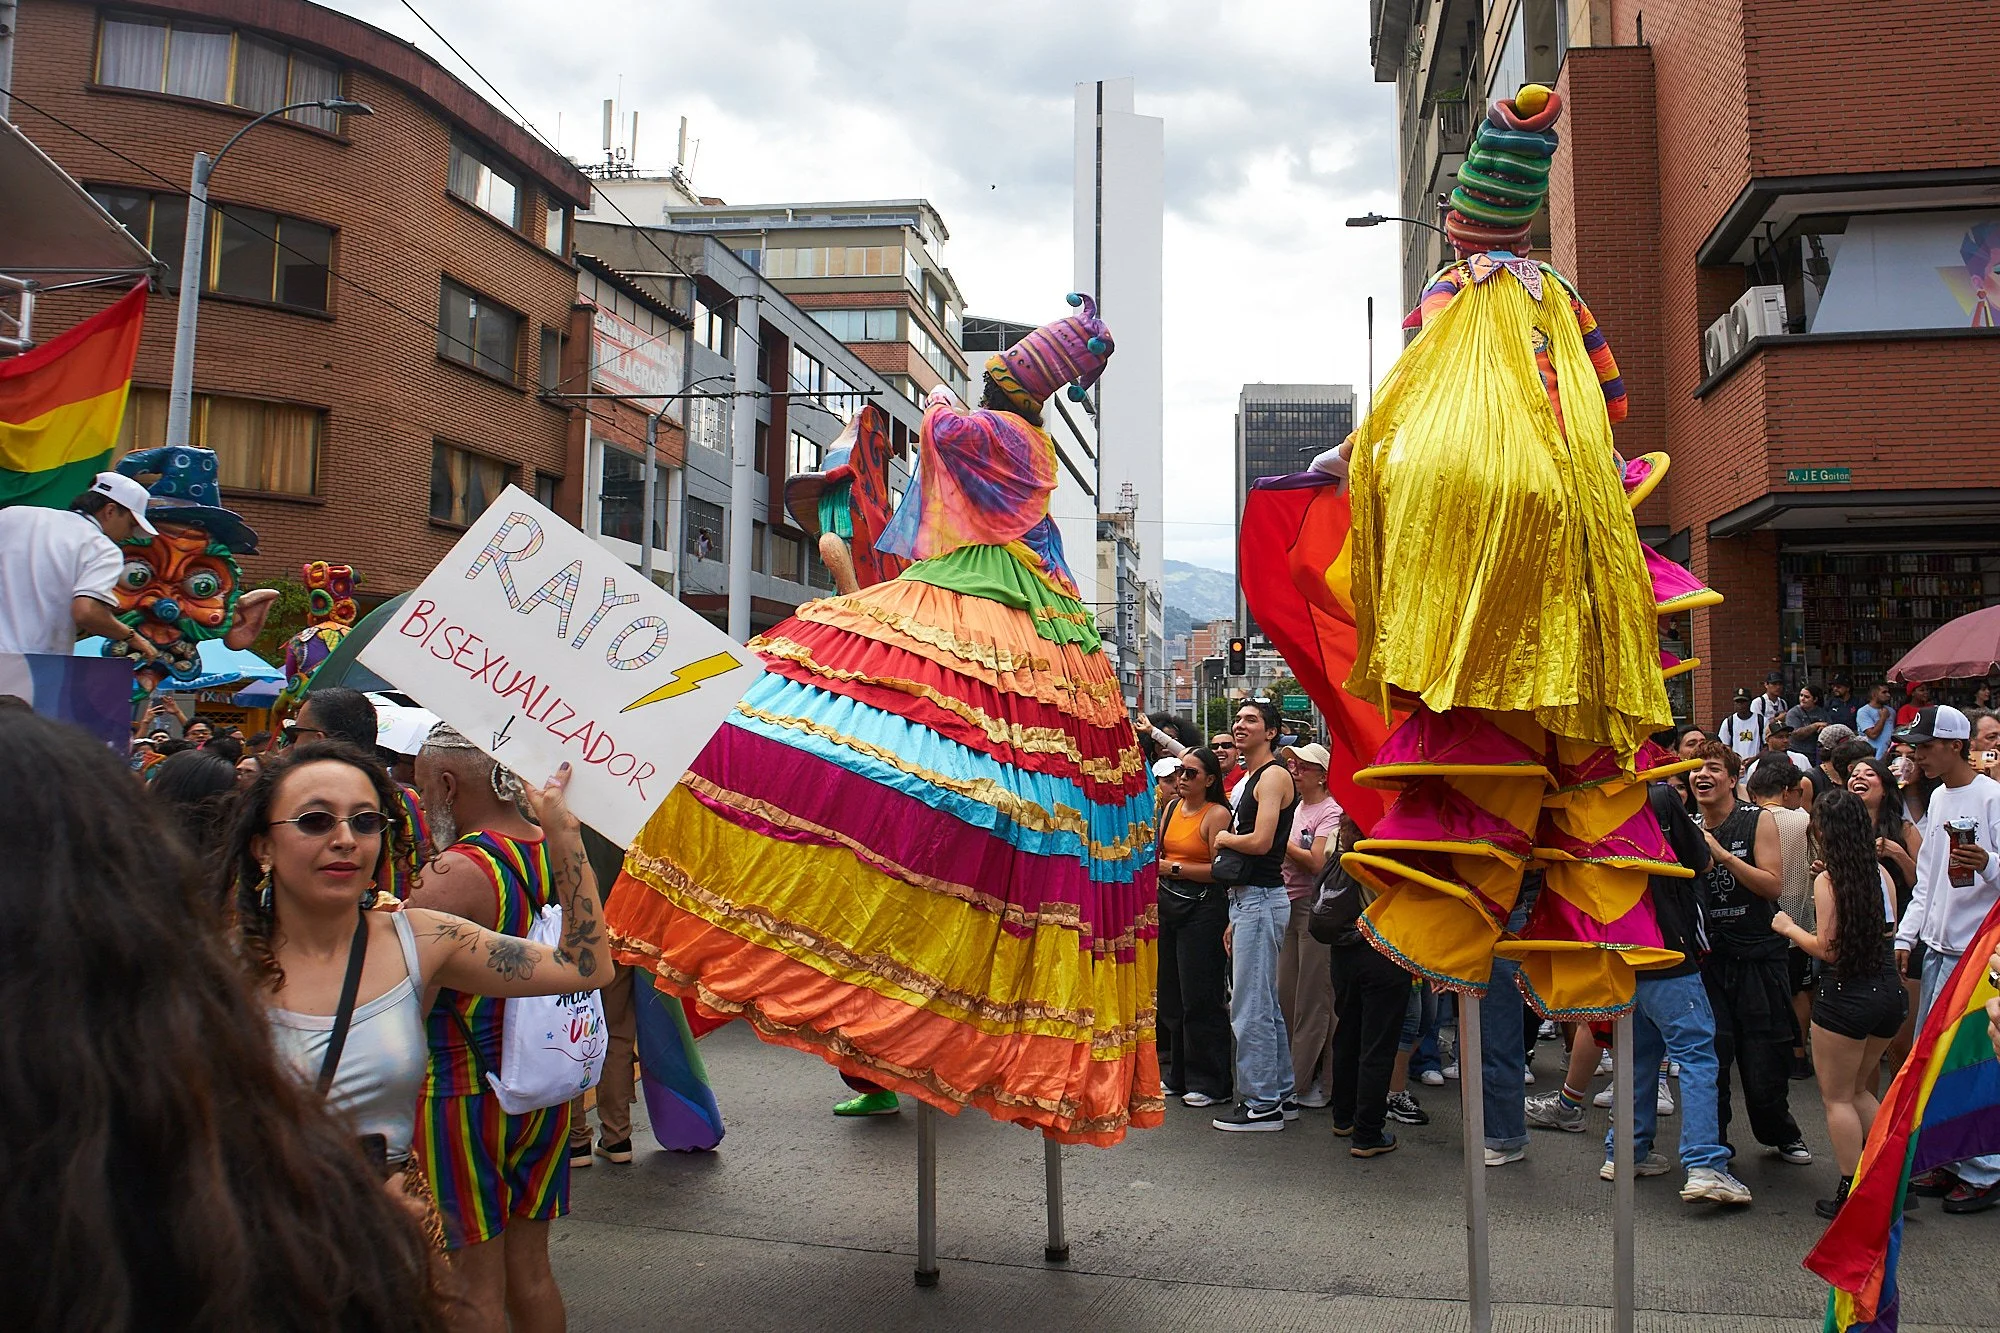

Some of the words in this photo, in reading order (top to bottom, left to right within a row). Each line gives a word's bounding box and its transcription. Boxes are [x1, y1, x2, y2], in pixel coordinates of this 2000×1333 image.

[621, 326, 633, 348] DE
[600, 340, 665, 394] MILAGROS
[1802, 471, 1808, 481] J
[1811, 471, 1817, 480] E
[465, 511, 668, 670] RAYO
[399, 600, 656, 801] BISEXUALIZADOR
